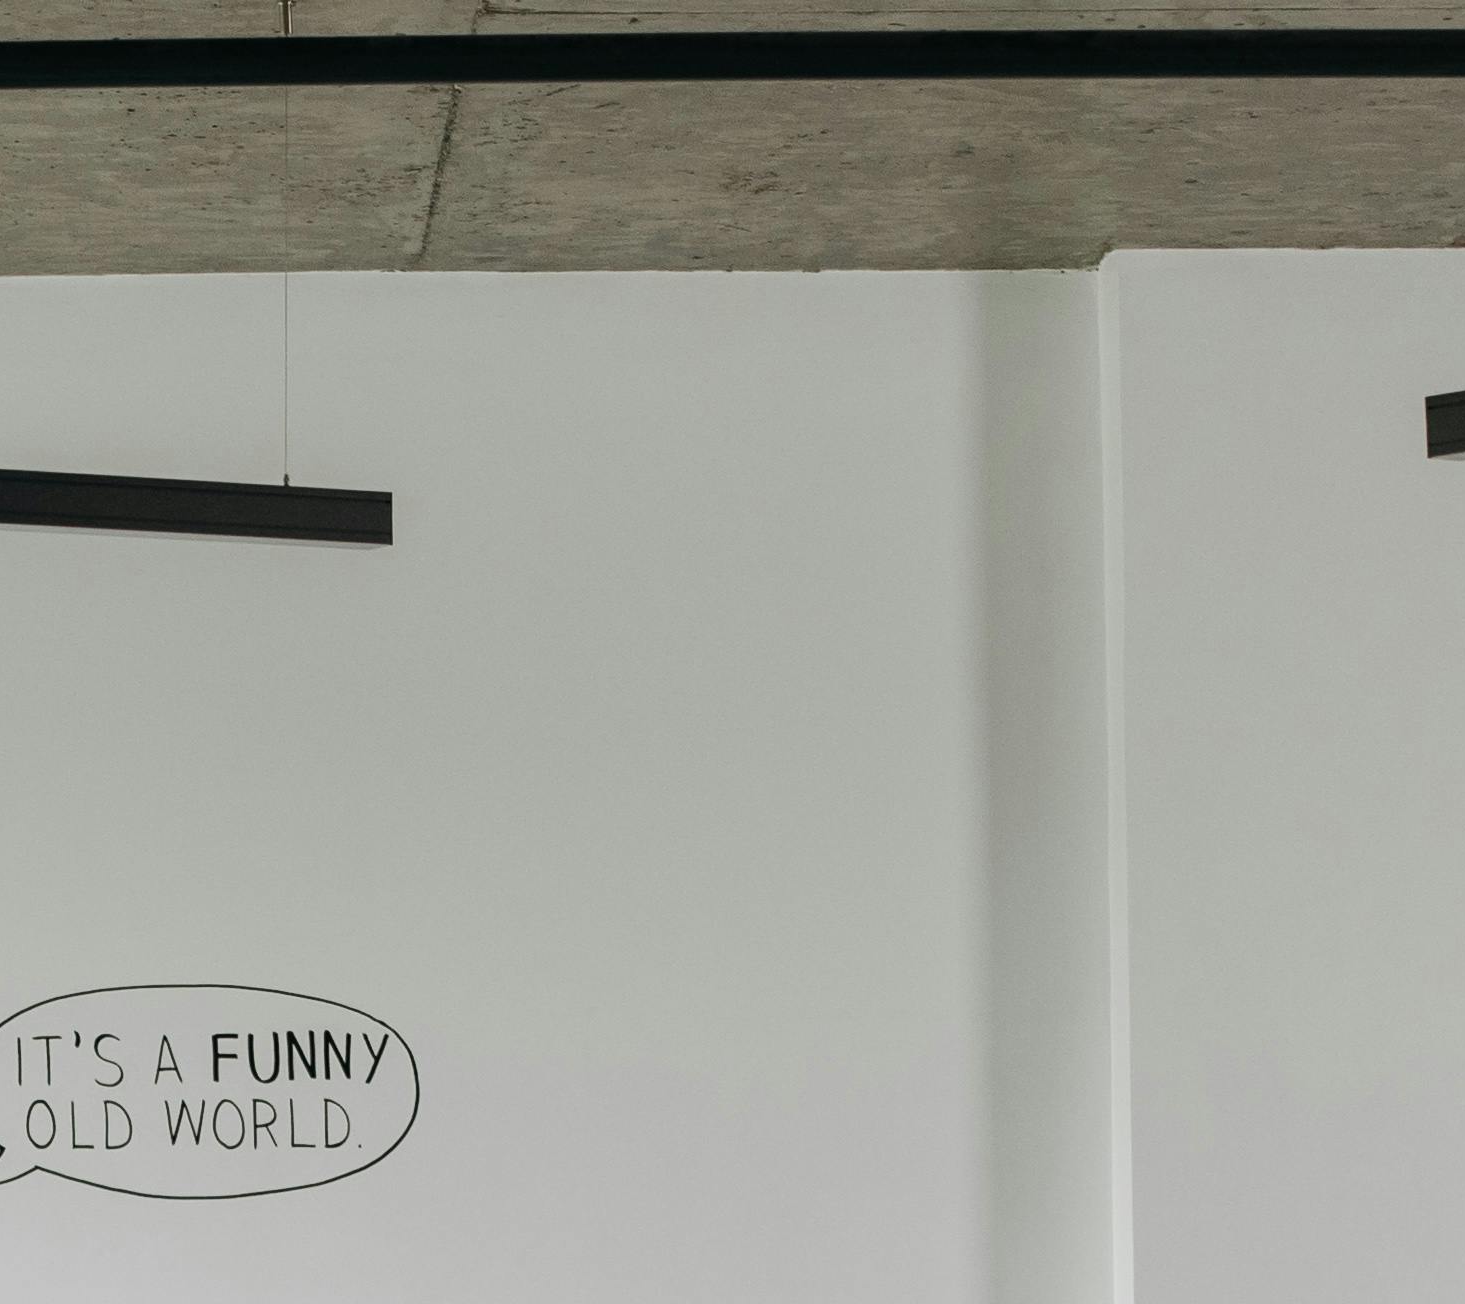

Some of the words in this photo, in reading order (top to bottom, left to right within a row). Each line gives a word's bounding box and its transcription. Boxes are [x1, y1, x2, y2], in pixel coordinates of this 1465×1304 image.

[16, 1030, 125, 1088] IT'S
[154, 1034, 183, 1085] A
[211, 1030, 389, 1085] FUNNY
[26, 1099, 133, 1150] OLD
[165, 1098, 363, 1150] WORLD.
